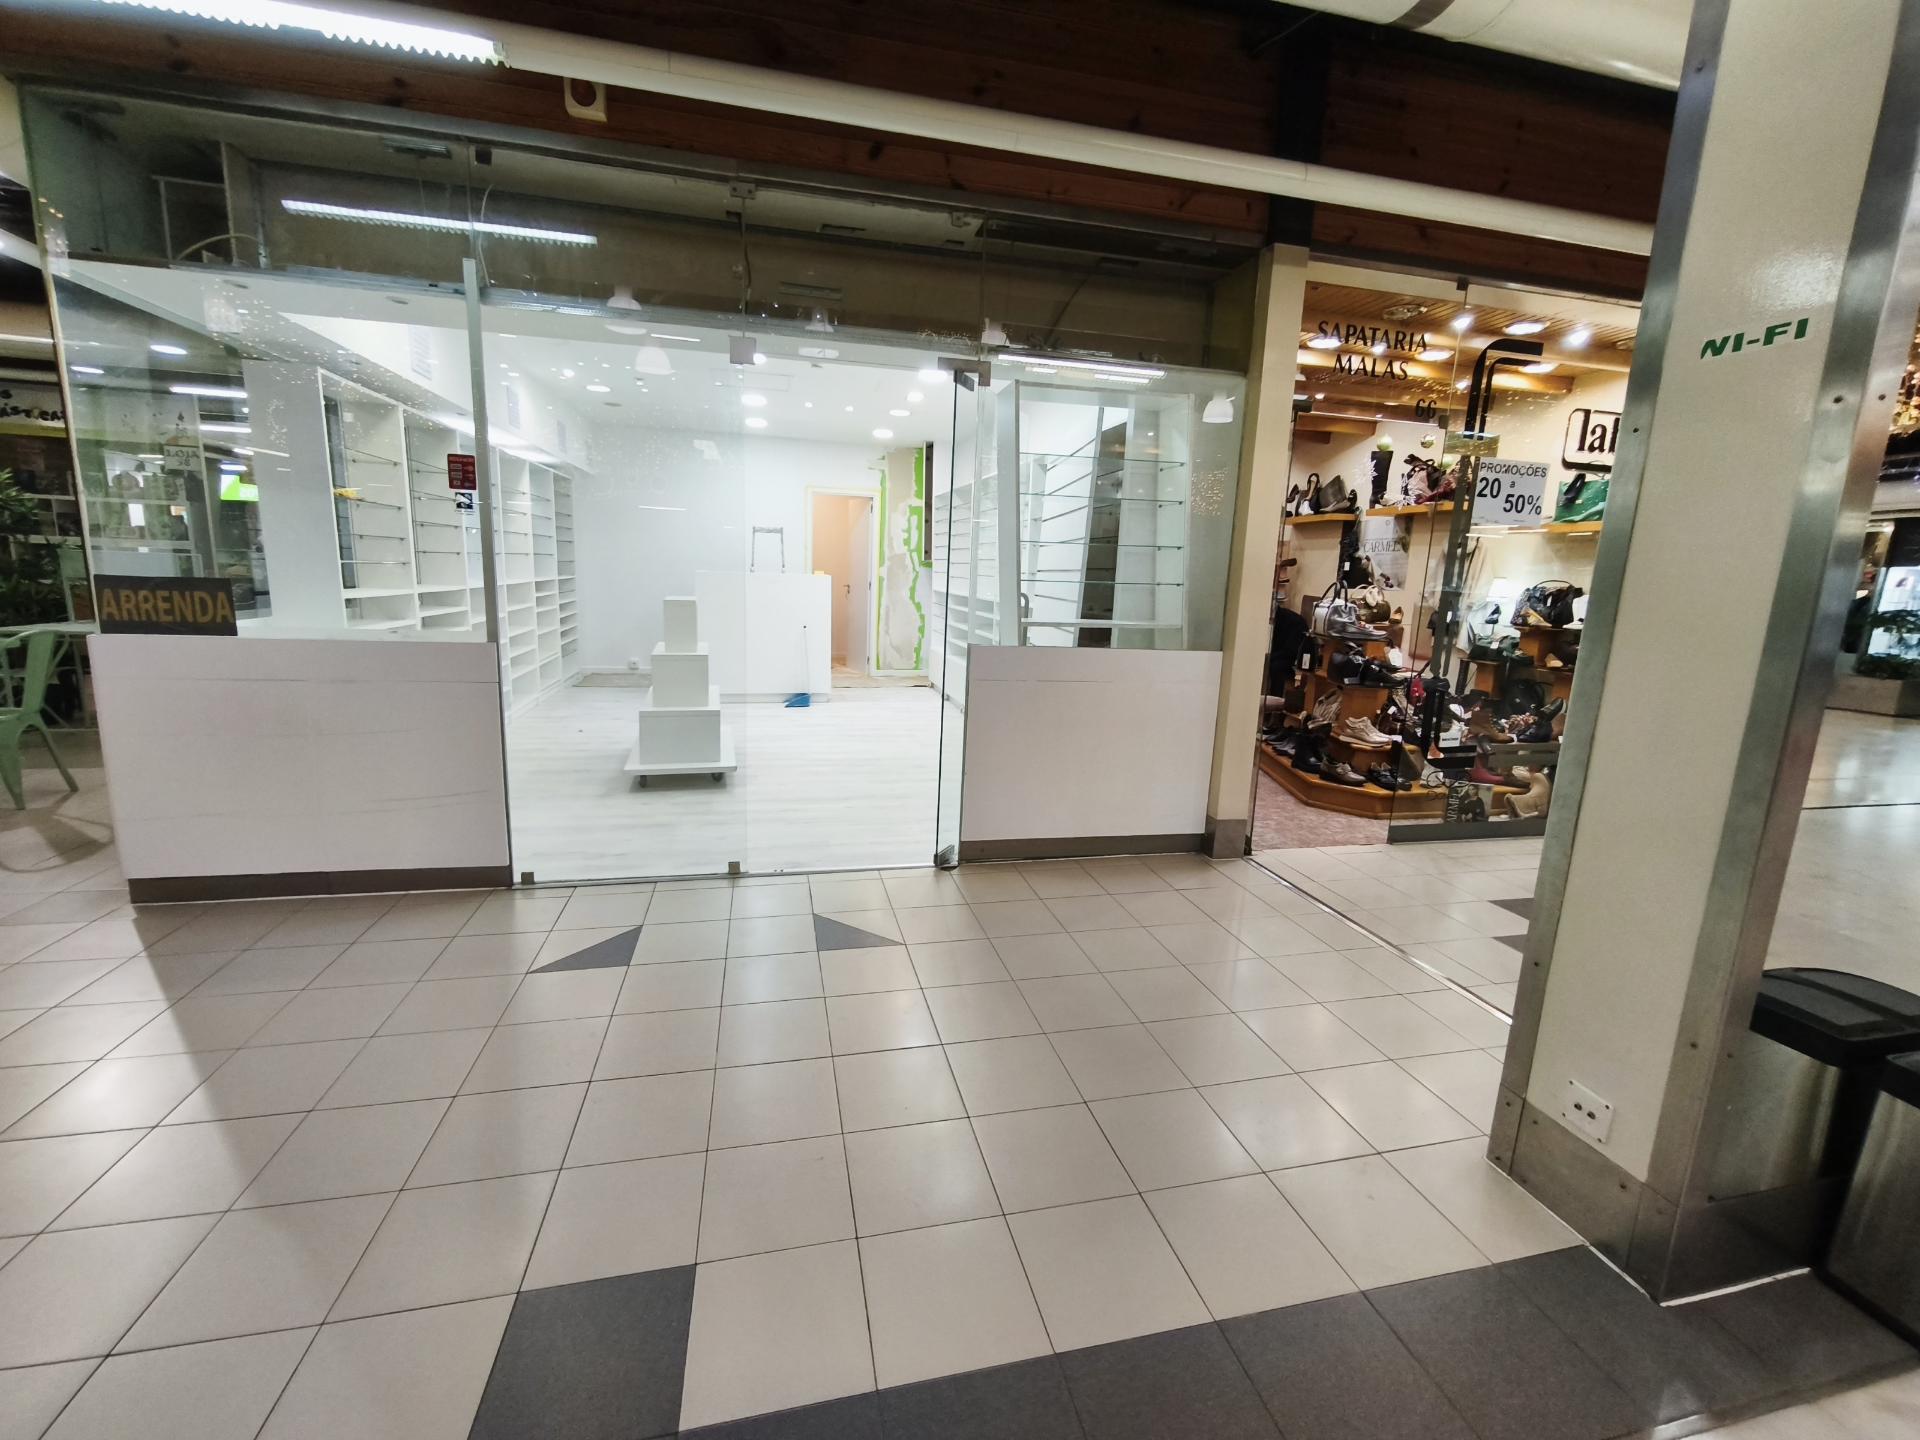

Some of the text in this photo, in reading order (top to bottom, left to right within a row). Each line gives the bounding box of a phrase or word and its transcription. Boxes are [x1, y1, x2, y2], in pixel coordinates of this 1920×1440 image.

[1318, 320, 1428, 352] SAPATARIA
[1333, 353, 1409, 381] MALAS
[1415, 398, 1437, 418] 66
[1479, 462, 1548, 478] PROMOÇÕES
[1476, 476, 1543, 515] 20 a 50%
[101, 587, 235, 624] ARRENDA
